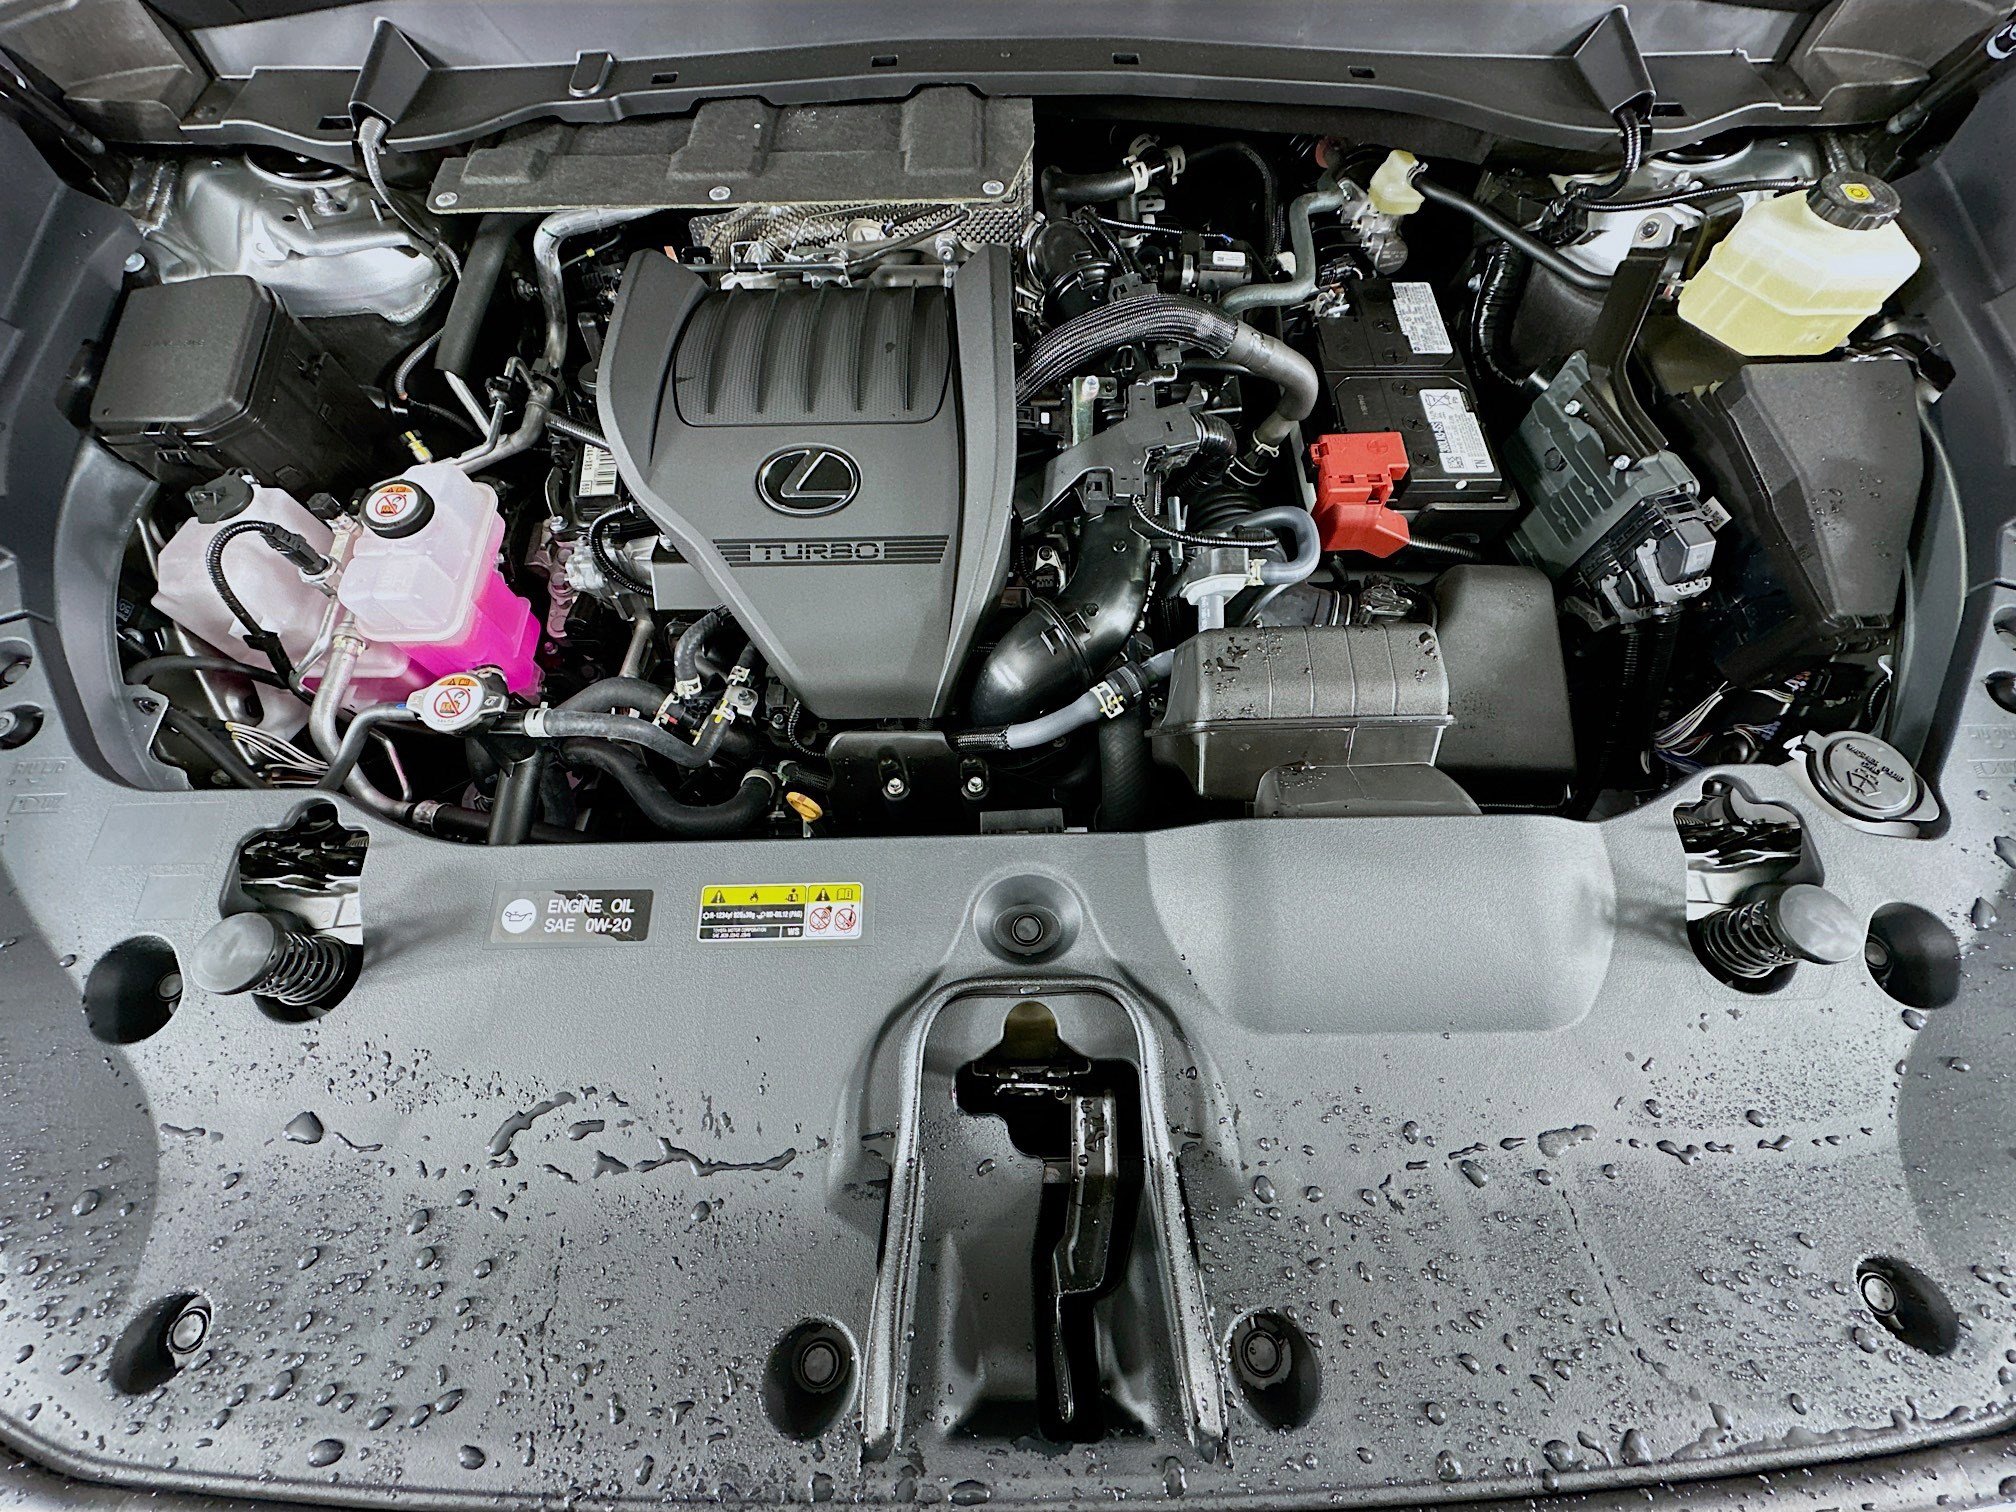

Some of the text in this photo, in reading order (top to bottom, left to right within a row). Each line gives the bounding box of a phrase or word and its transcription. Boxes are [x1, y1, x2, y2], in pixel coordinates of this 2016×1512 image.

[755, 542, 880, 560] TURBO
[547, 898, 635, 914] ENGINE OIL
[543, 917, 632, 933] SAE 0W-20
[787, 927, 800, 936] WS
